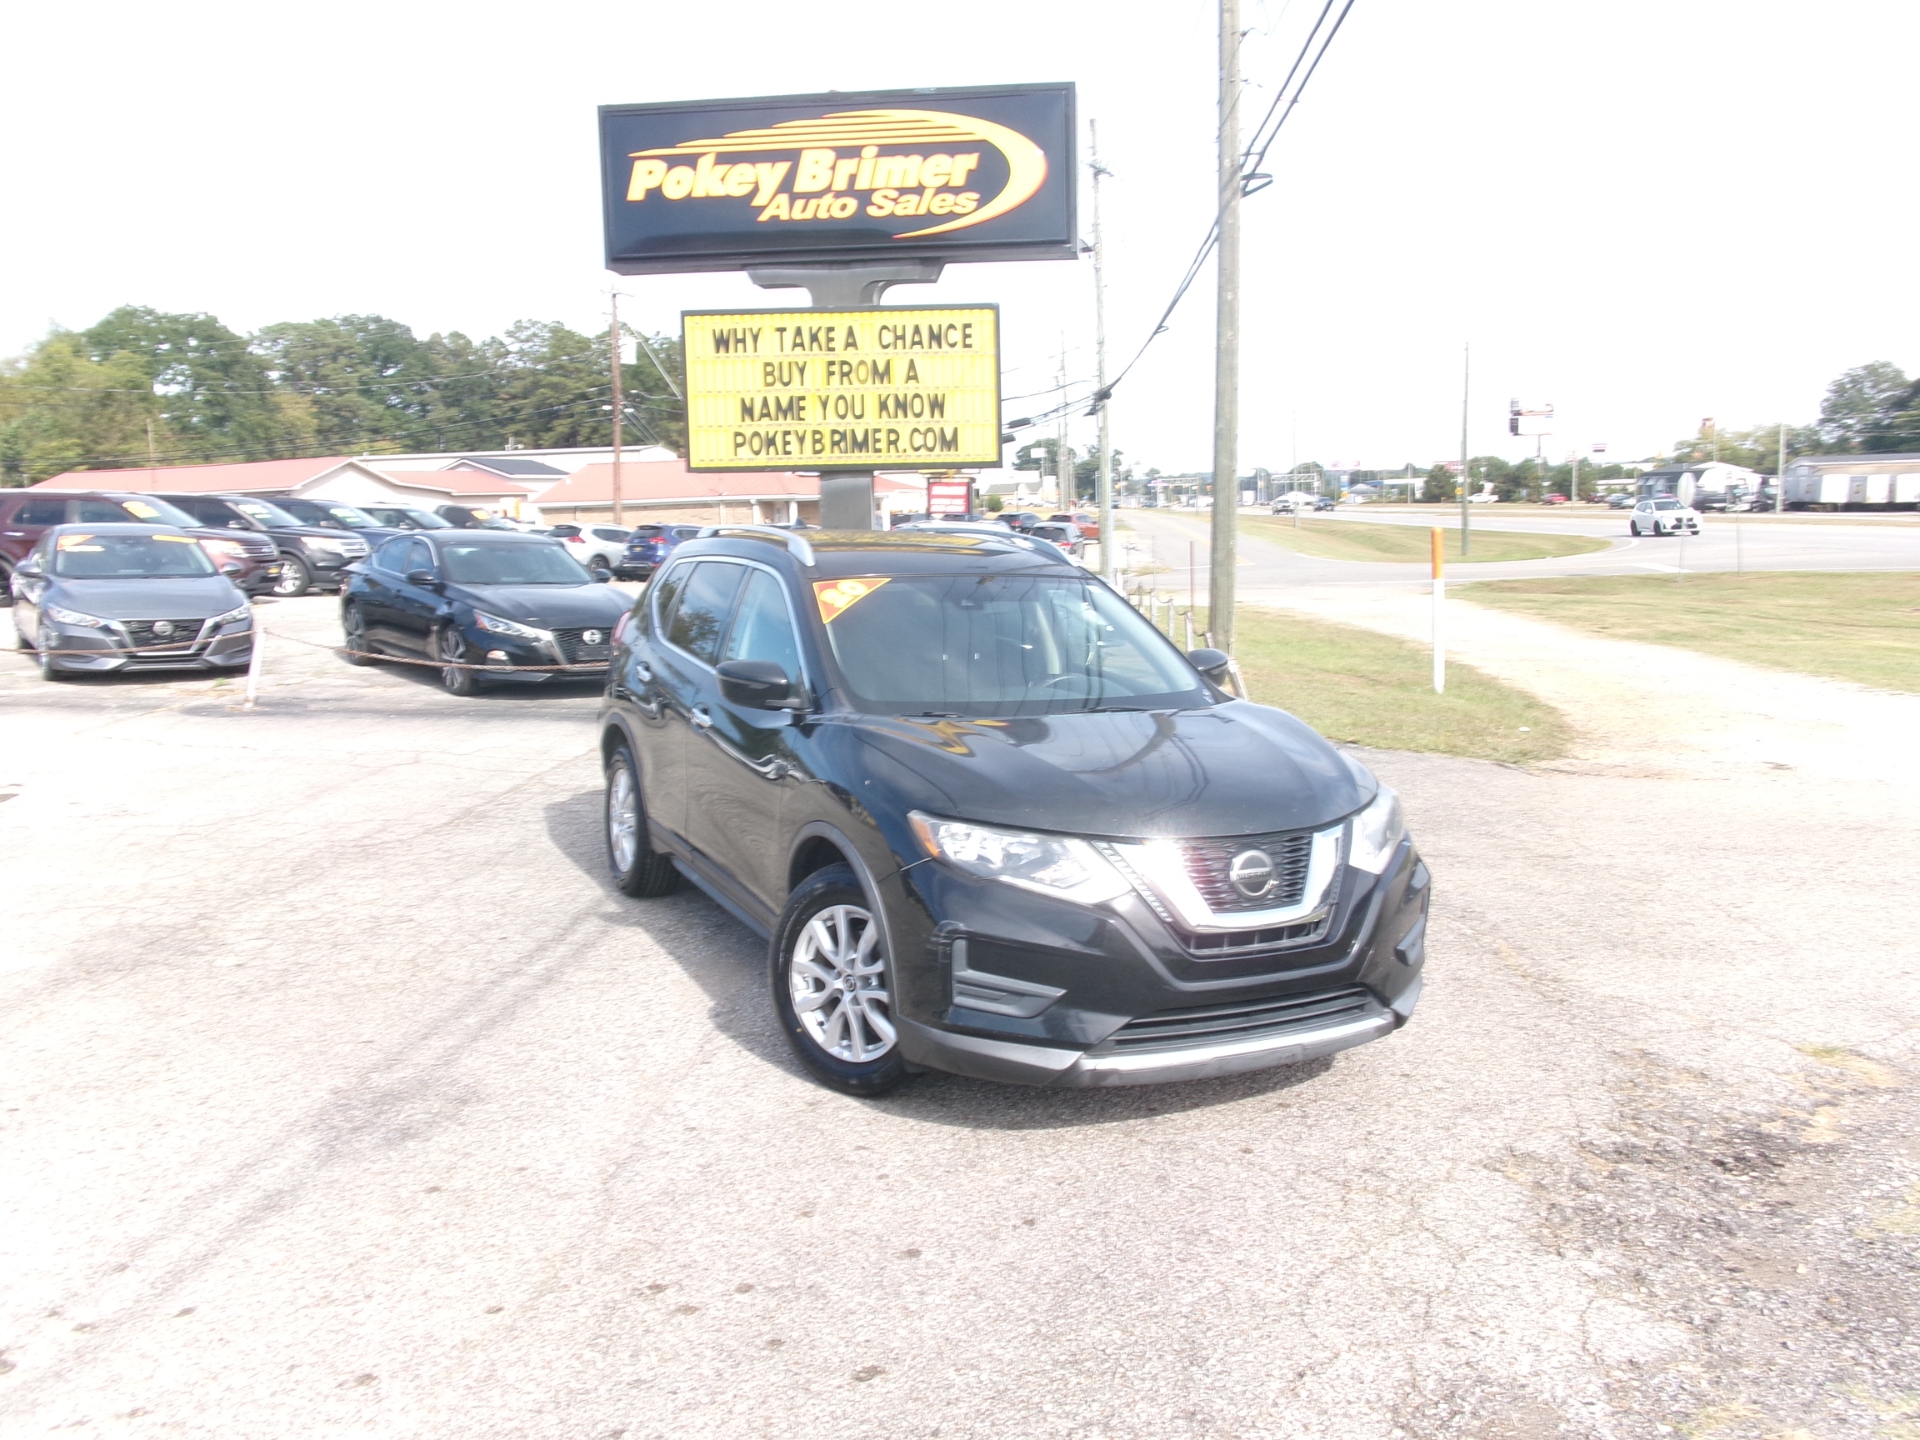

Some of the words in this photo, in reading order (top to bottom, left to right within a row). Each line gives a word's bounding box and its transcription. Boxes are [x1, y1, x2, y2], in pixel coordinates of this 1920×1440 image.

[626, 151, 792, 206] Pokey
[793, 145, 980, 193] Brimer
[757, 192, 858, 222] Auto
[866, 188, 981, 218] Sales
[713, 327, 762, 354] WHY
[775, 326, 836, 352] TAKE
[843, 325, 859, 351] A
[878, 323, 973, 350] CHANCE
[764, 361, 807, 387] BUY
[826, 359, 891, 386] FROM
[905, 359, 920, 384] A
[740, 396, 806, 423] NAME
[817, 394, 865, 420] YOU
[878, 393, 946, 419] KNOW
[733, 427, 959, 456] POKEYBRIMER.COM
